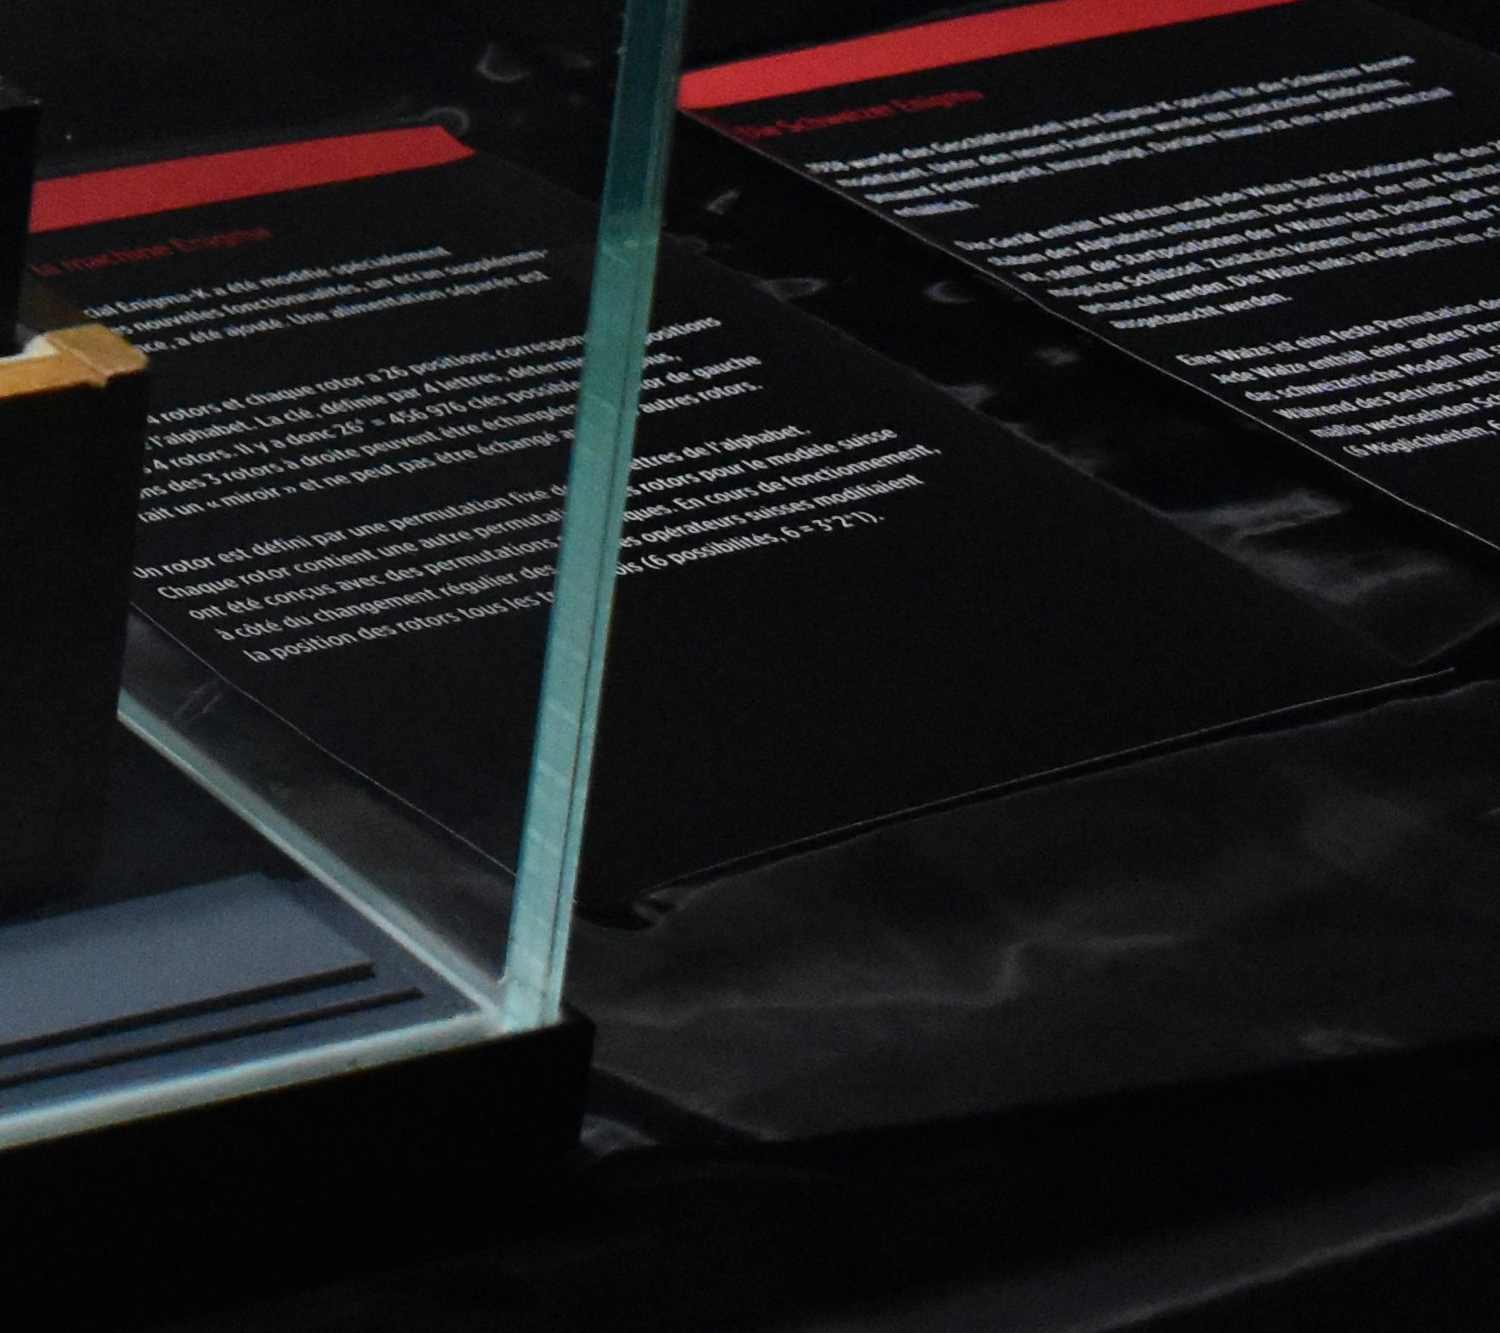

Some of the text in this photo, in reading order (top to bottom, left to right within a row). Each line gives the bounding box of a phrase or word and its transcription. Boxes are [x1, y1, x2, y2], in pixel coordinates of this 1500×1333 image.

[150, 420, 257, 447] l'alphabet.
[253, 415, 285, 427] La
[283, 407, 323, 422] clé,
[320, 395, 388, 414] définie
[387, 388, 421, 403] par
[435, 373, 511, 390] lettres,
[160, 404, 222, 422] rotors
[221, 398, 246, 410] et
[245, 386, 316, 405] chaque
[315, 376, 364, 392] rotor
[378, 366, 409, 380] 26
[409, 352, 496, 375] positions
[168, 478, 206, 492] des
[222, 463, 284, 482] rotors
[300, 449, 360, 466] droite
[360, 431, 442, 456] peuvent
[438, 424, 483, 438] être
[665, 372, 694, 383] de
[692, 356, 761, 379] gauche
[169, 449, 237, 467] rotors.
[233, 443, 255, 455] Il
[286, 429, 336, 445] donc
[389, 408, 429, 424] 456
[425, 401, 467, 417] 976
[467, 395, 508, 409] clés
[173, 382, 763, 515] un miroir et ne peut pas être échangé autres rotors.
[157, 429, 897, 599] Chaque rotor contient une autre rotors pour le modèle suisse
[162, 557, 216, 574] rotor
[217, 548, 253, 563] est
[252, 535, 313, 556] défini
[311, 530, 347, 546] par
[348, 523, 389, 537] une
[389, 497, 513, 531] permutation
[508, 490, 551, 503] fixe
[682, 443, 711, 458] de
[705, 426, 811, 453] l'alphabet.
[189, 605, 228, 620] ont
[264, 584, 337, 606] conçus
[335, 575, 386, 591] avec
[385, 567, 424, 581] des
[423, 539, 557, 575] permutations
[674, 497, 707, 510] En
[704, 487, 759, 504] cours
[757, 481, 786, 493] de
[781, 445, 941, 487] fonctionnement,
[235, 619, 283, 637] côté
[282, 616, 314, 628] du
[314, 589, 441, 622] changement
[439, 573, 518, 596] régulier
[520, 565, 555, 579] des
[641, 515, 747, 542] opérateurs
[744, 500, 815, 521] suisses
[813, 474, 924, 506] modifiaient
[243, 650, 271, 662] la
[270, 633, 358, 660] position
[357, 625, 397, 640] des
[396, 613, 461, 632] rotors
[457, 598, 508, 619] tous
[503, 596, 539, 609] les
[640, 554, 669, 570] (6
[667, 533, 787, 565] possibilités,
